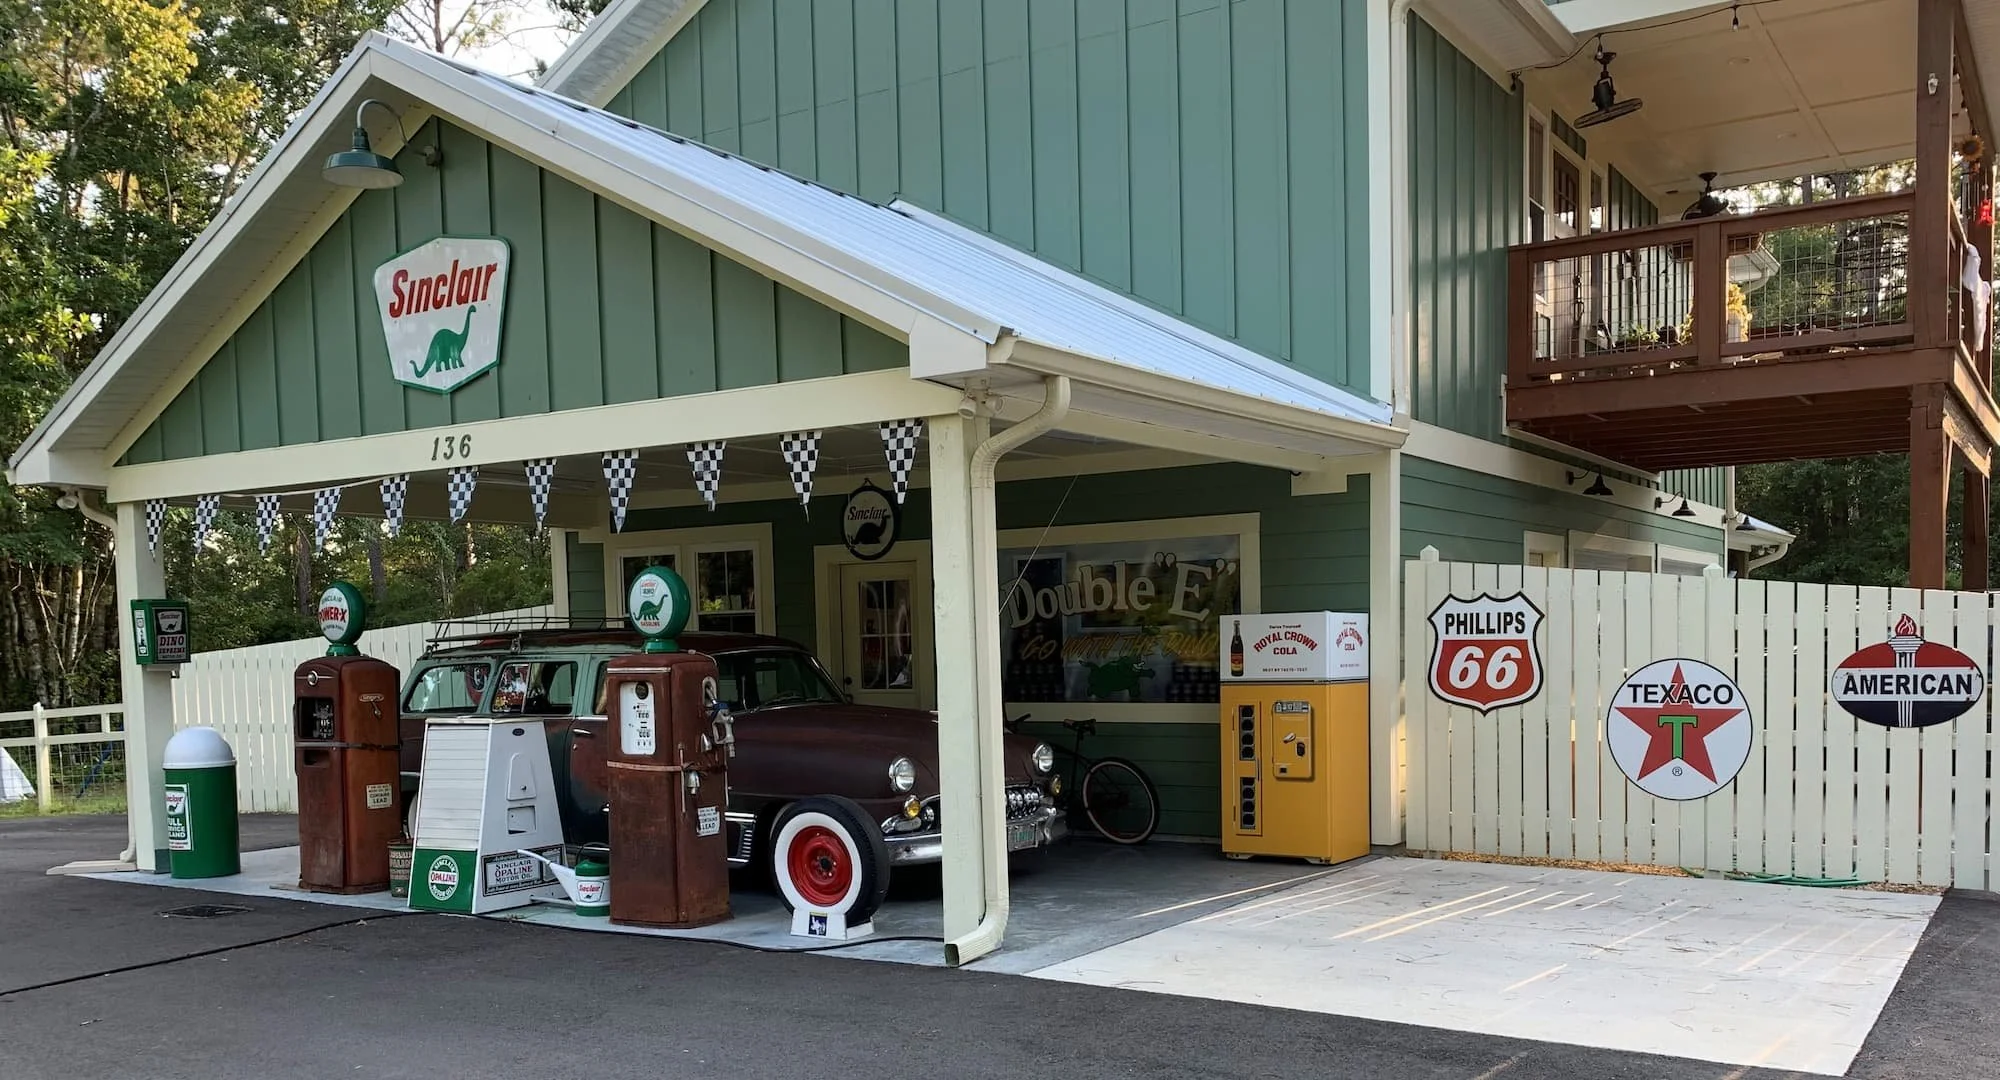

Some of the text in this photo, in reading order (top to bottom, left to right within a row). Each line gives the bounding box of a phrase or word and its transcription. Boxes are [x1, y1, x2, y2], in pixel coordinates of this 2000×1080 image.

[389, 258, 497, 319] Sinclair
[431, 433, 471, 461] 136
[847, 505, 887, 520] Sinclair
[1000, 560, 1155, 629] Double
[1445, 611, 1526, 635] PHILLIPS
[160, 635, 185, 646] DINO
[1253, 630, 1318, 653] ROYAL CROWN
[1273, 647, 1298, 655] COLA
[1449, 645, 1523, 690] 66
[1627, 684, 1733, 705] TEXACO
[1843, 673, 1972, 695] AMERICAN
[1658, 714, 1698, 761] T
[434, 859, 457, 872] SINCLAIR
[495, 865, 533, 878] OPALINE
[496, 860, 531, 869] SINCLAIR
[431, 871, 457, 883] OPALINE
[495, 875, 520, 883] MOTOR
